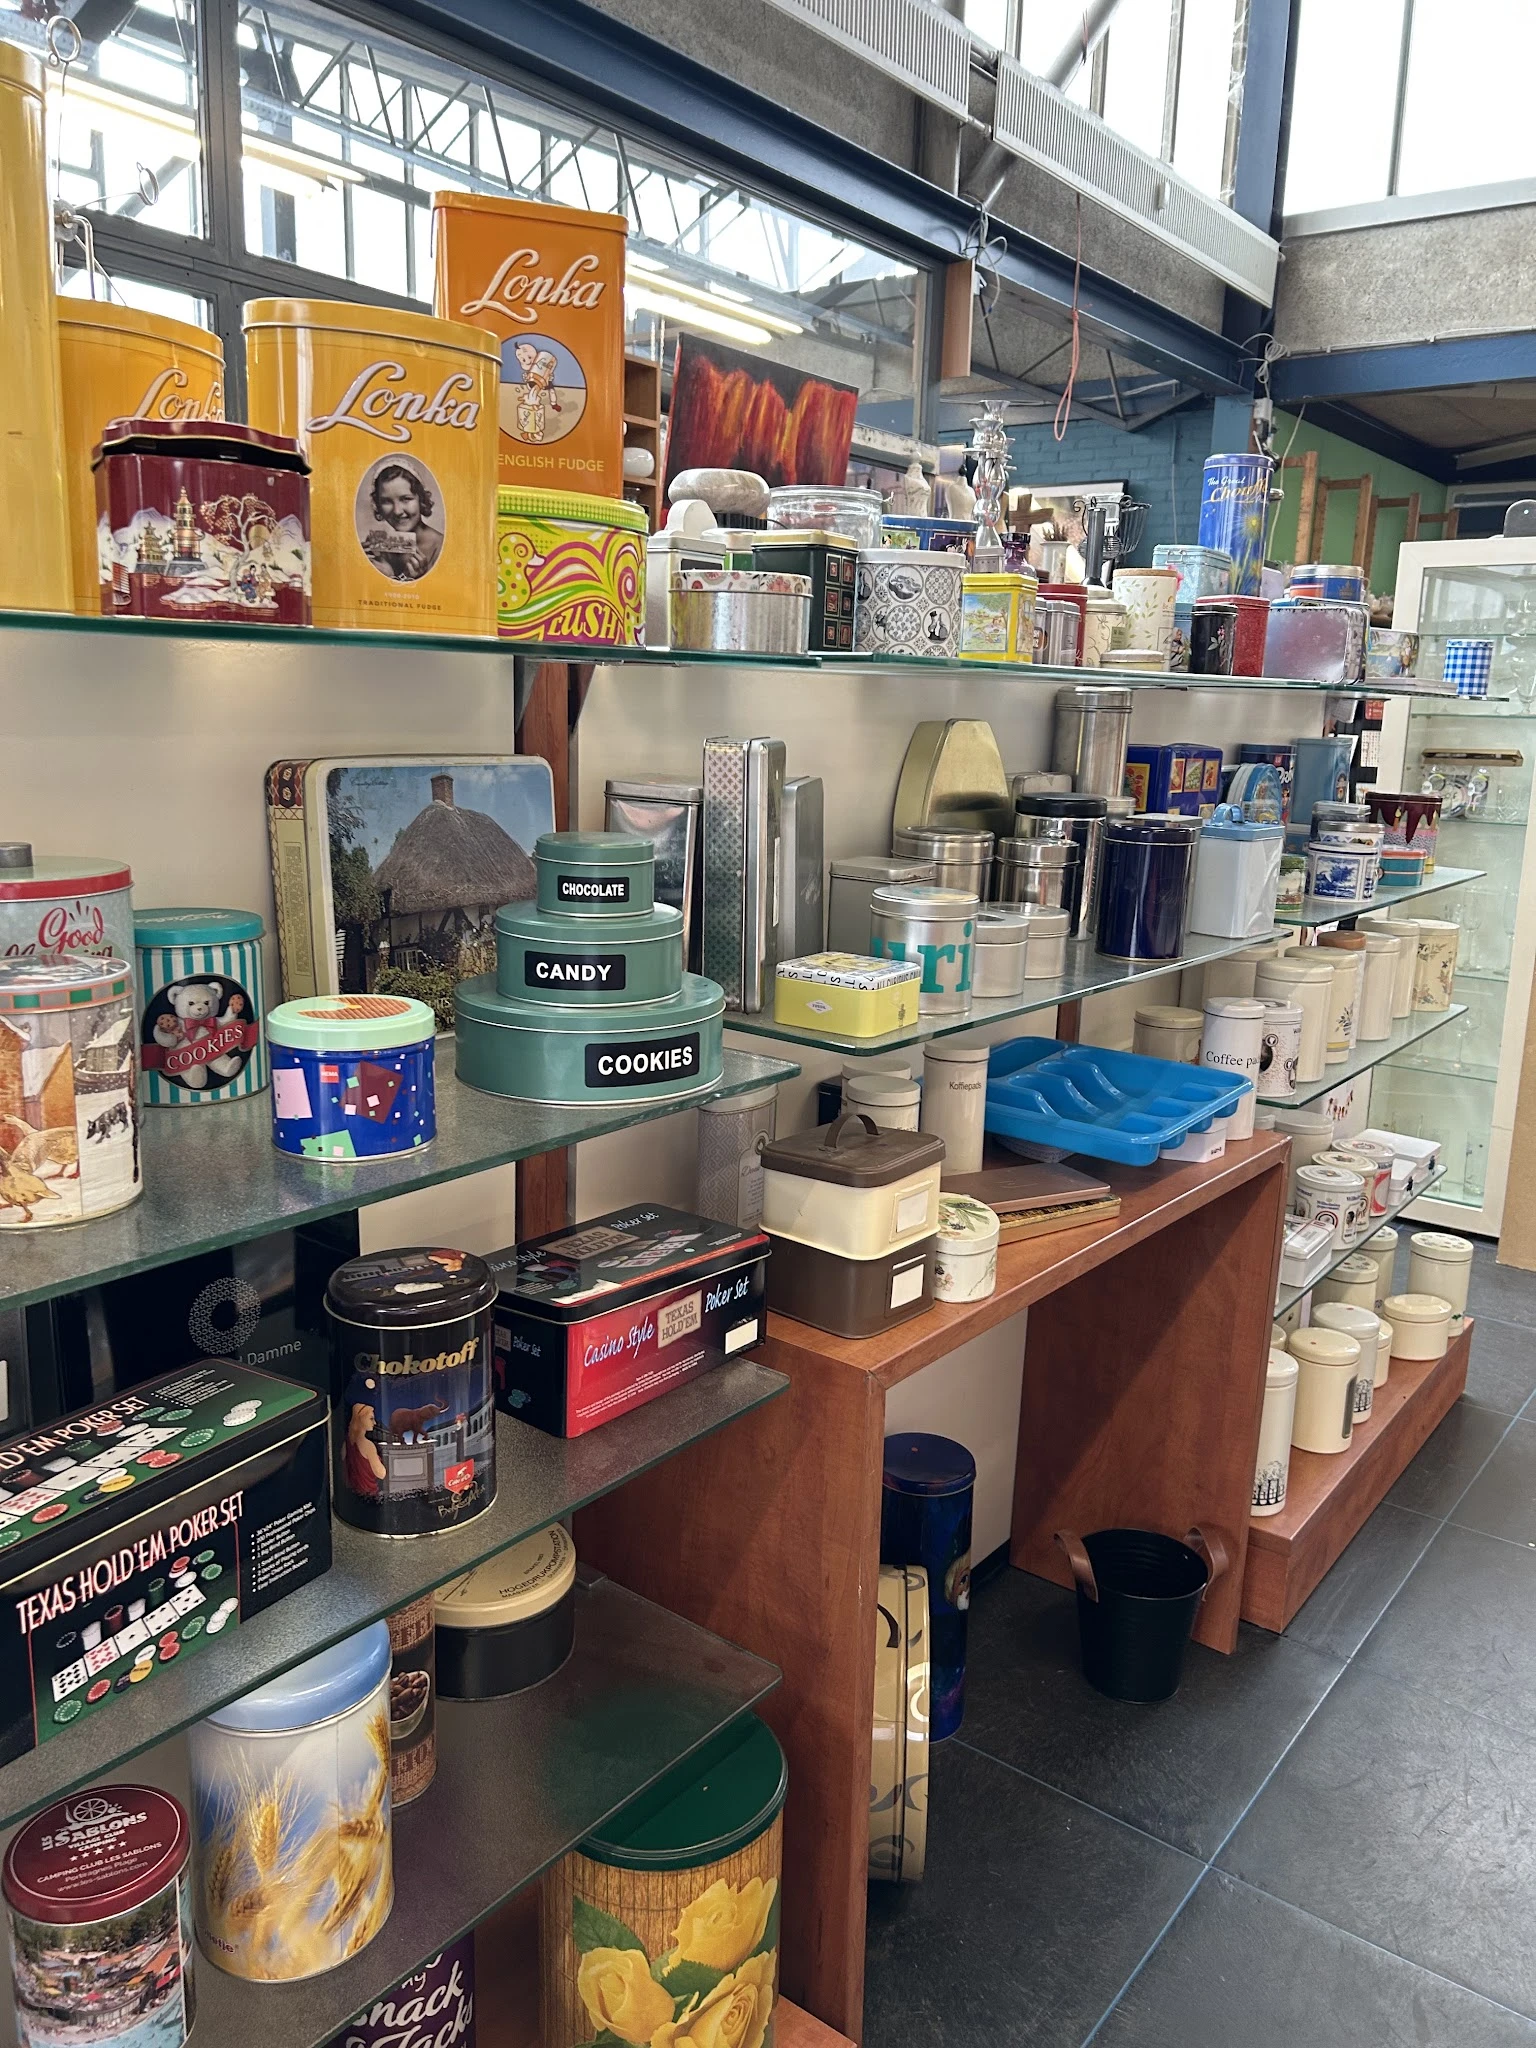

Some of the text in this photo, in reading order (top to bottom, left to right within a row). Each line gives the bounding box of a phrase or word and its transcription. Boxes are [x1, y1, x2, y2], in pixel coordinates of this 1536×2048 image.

[460, 248, 606, 325] Lonka
[305, 360, 480, 443] Lonka
[499, 454, 605, 472] ENGLISH FUDGE
[358, 600, 442, 611] TRADITIONAL FUDGE
[562, 882, 625, 898] CHOCOLATE
[38, 906, 105, 955] Good
[535, 963, 612, 982] CANDY
[166, 1024, 244, 1071] COOKIES
[597, 1045, 693, 1076] COOKIES
[1206, 1050, 1243, 1067] Coffee
[949, 1080, 982, 1092] Koffiepads
[516, 1249, 547, 1263] Style
[704, 1275, 750, 1313] Poker Set
[661, 1312, 699, 1341] HOLD'EM
[665, 1300, 695, 1325] TEXAS
[247, 1340, 302, 1366] Damme
[354, 1336, 480, 1376] Chokotoff
[584, 1315, 655, 1368] Casino Style
[53, 1408, 123, 1441] POKER
[111, 1395, 150, 1415] SET
[16, 1490, 244, 1635] TEXAS HOLD'EM POKER SET
[499, 1530, 562, 1595] HOGEDRUKPOMPSTATION
[41, 1811, 148, 1851] LES SABLONS
[78, 1837, 117, 1851] CAMPING
[103, 1829, 125, 1839] CLUB
[37, 1842, 162, 1883] CAMPING CLUB LES SABLONS
[57, 1861, 148, 1892] www.les-sablons.com
[113, 1857, 138, 1868] Plage
